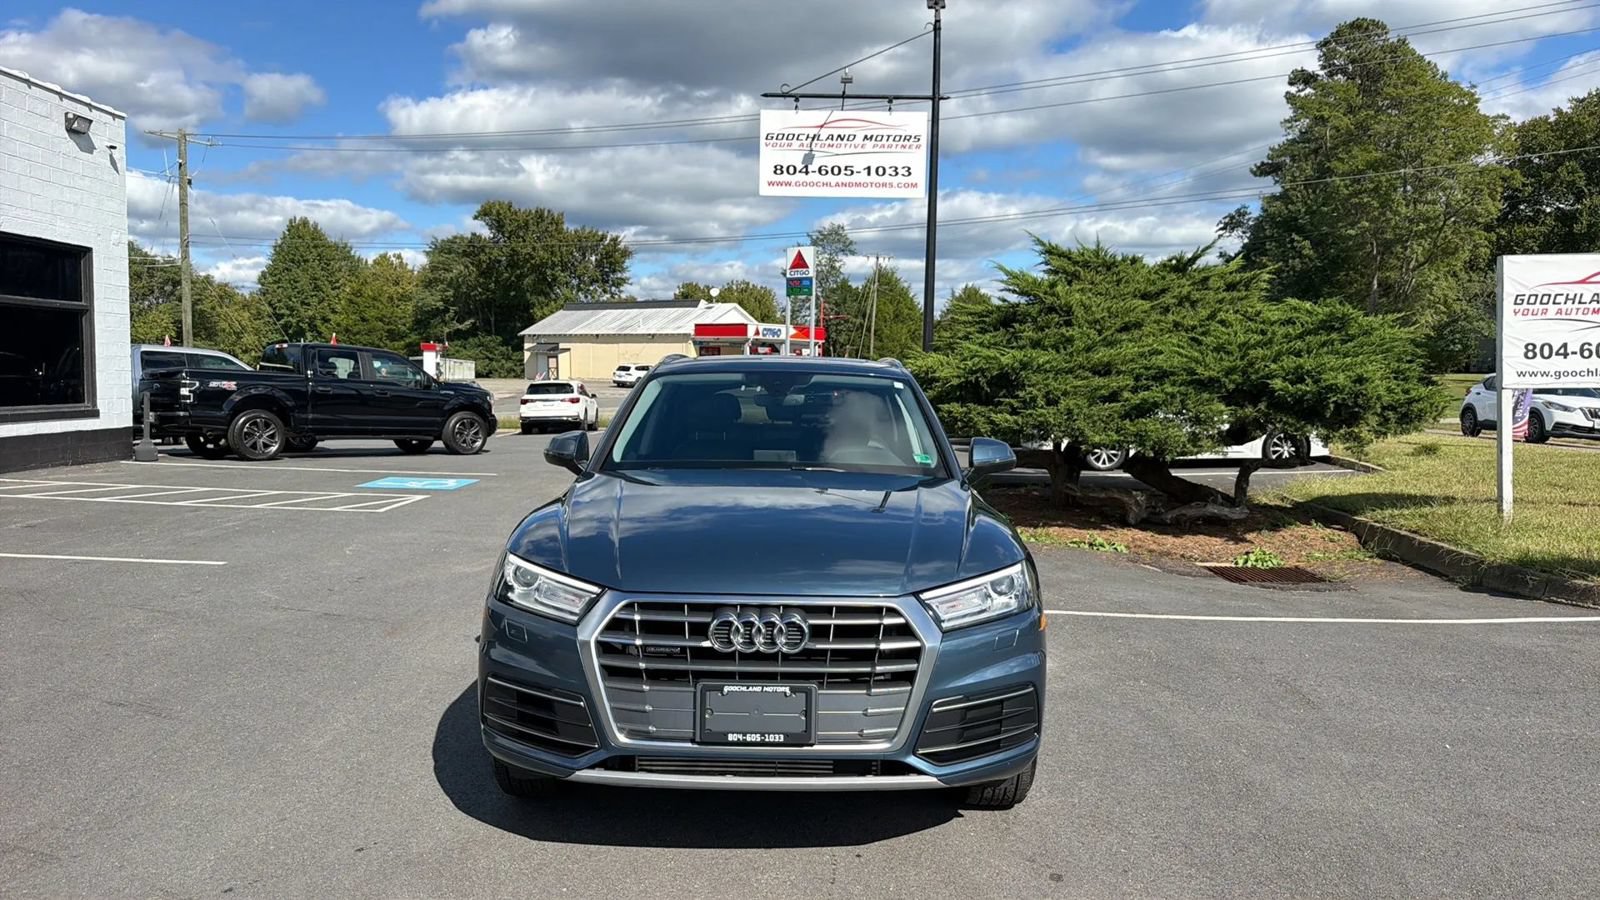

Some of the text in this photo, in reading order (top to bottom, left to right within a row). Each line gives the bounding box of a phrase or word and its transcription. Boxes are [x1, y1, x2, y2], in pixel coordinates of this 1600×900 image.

[765, 132, 922, 143] GOOCHLAND MOTORS
[773, 164, 913, 177] 804-605-1033
[767, 180, 918, 189] WWW.GOOCHLANDMOTORS.COM
[1513, 308, 1549, 316] YOUR
[762, 327, 782, 338] CITGO
[728, 733, 784, 742] 804-605-1033
